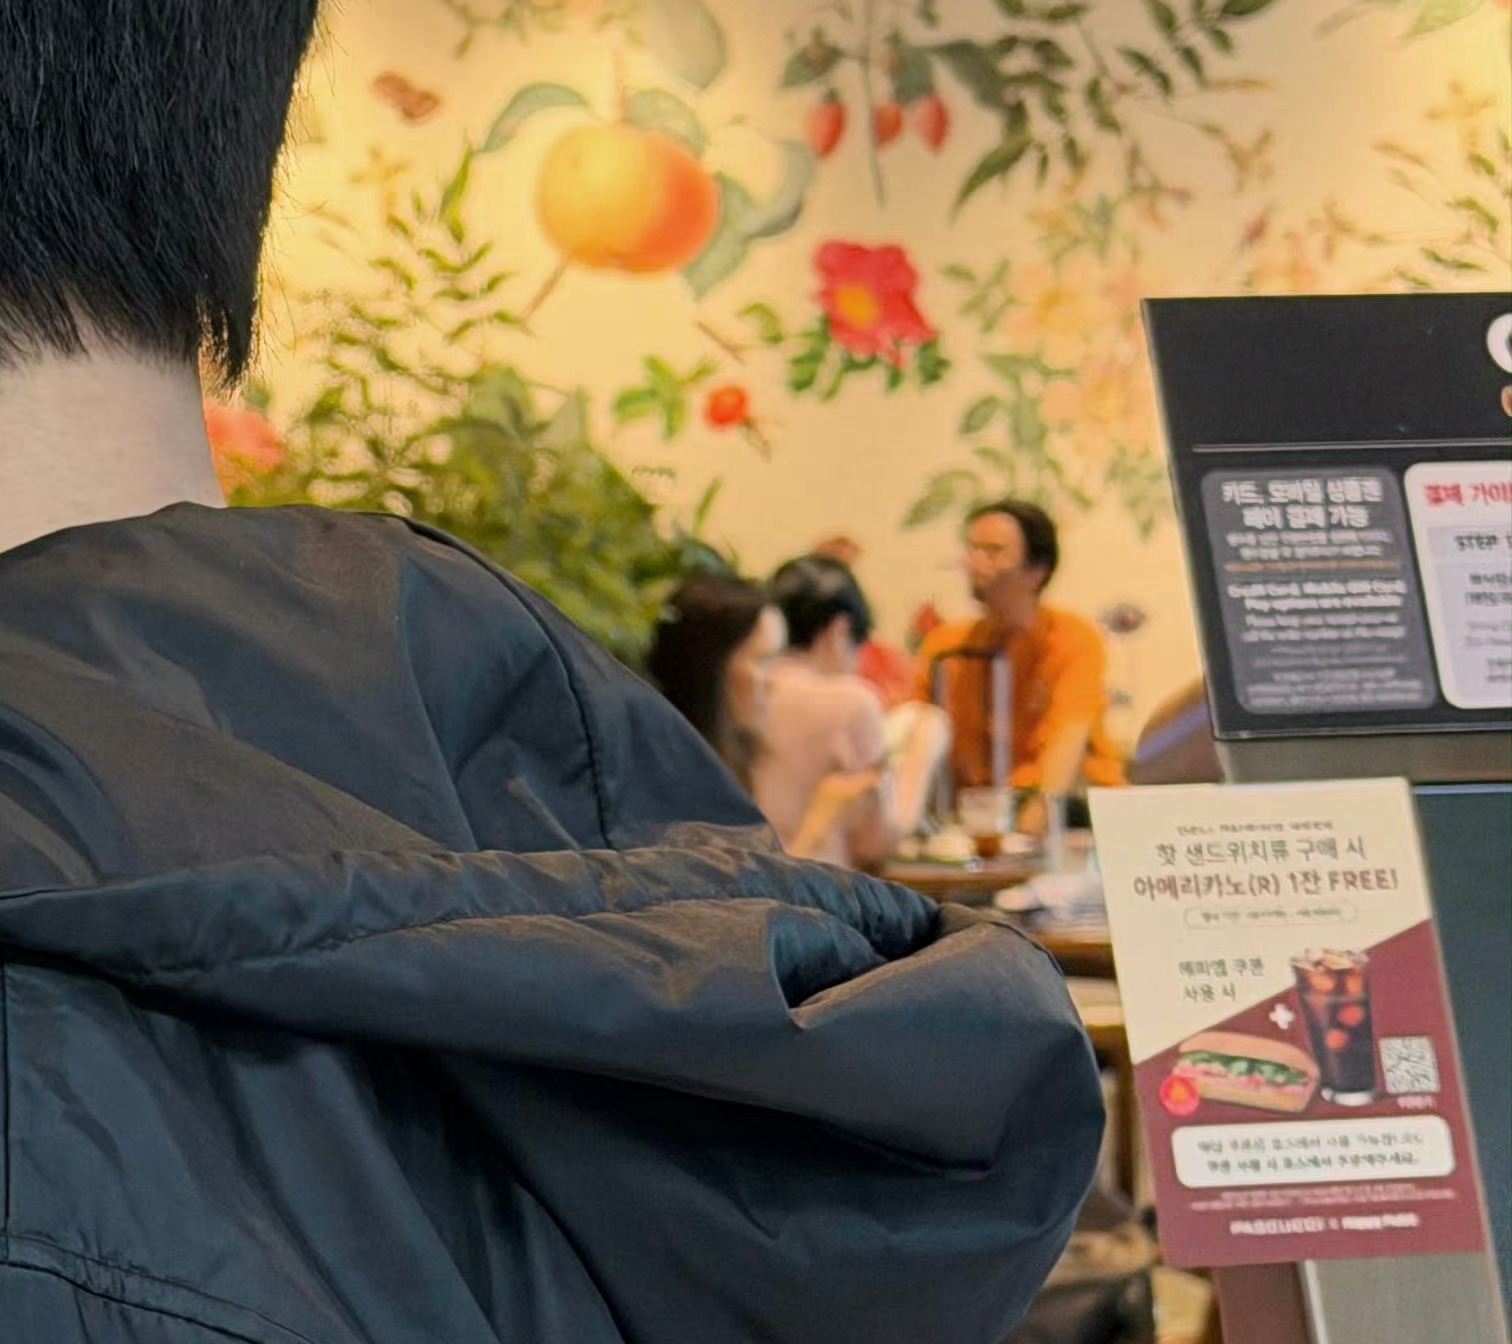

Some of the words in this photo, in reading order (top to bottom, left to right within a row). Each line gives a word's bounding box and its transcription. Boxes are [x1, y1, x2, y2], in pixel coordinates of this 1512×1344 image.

[1187, 839, 1290, 866] 샌드위치류
[1346, 836, 1366, 859] 시
[1133, 873, 1281, 901] 아메리카노(R)
[1289, 869, 1322, 895] 1잔
[1328, 867, 1399, 893] FREE!
